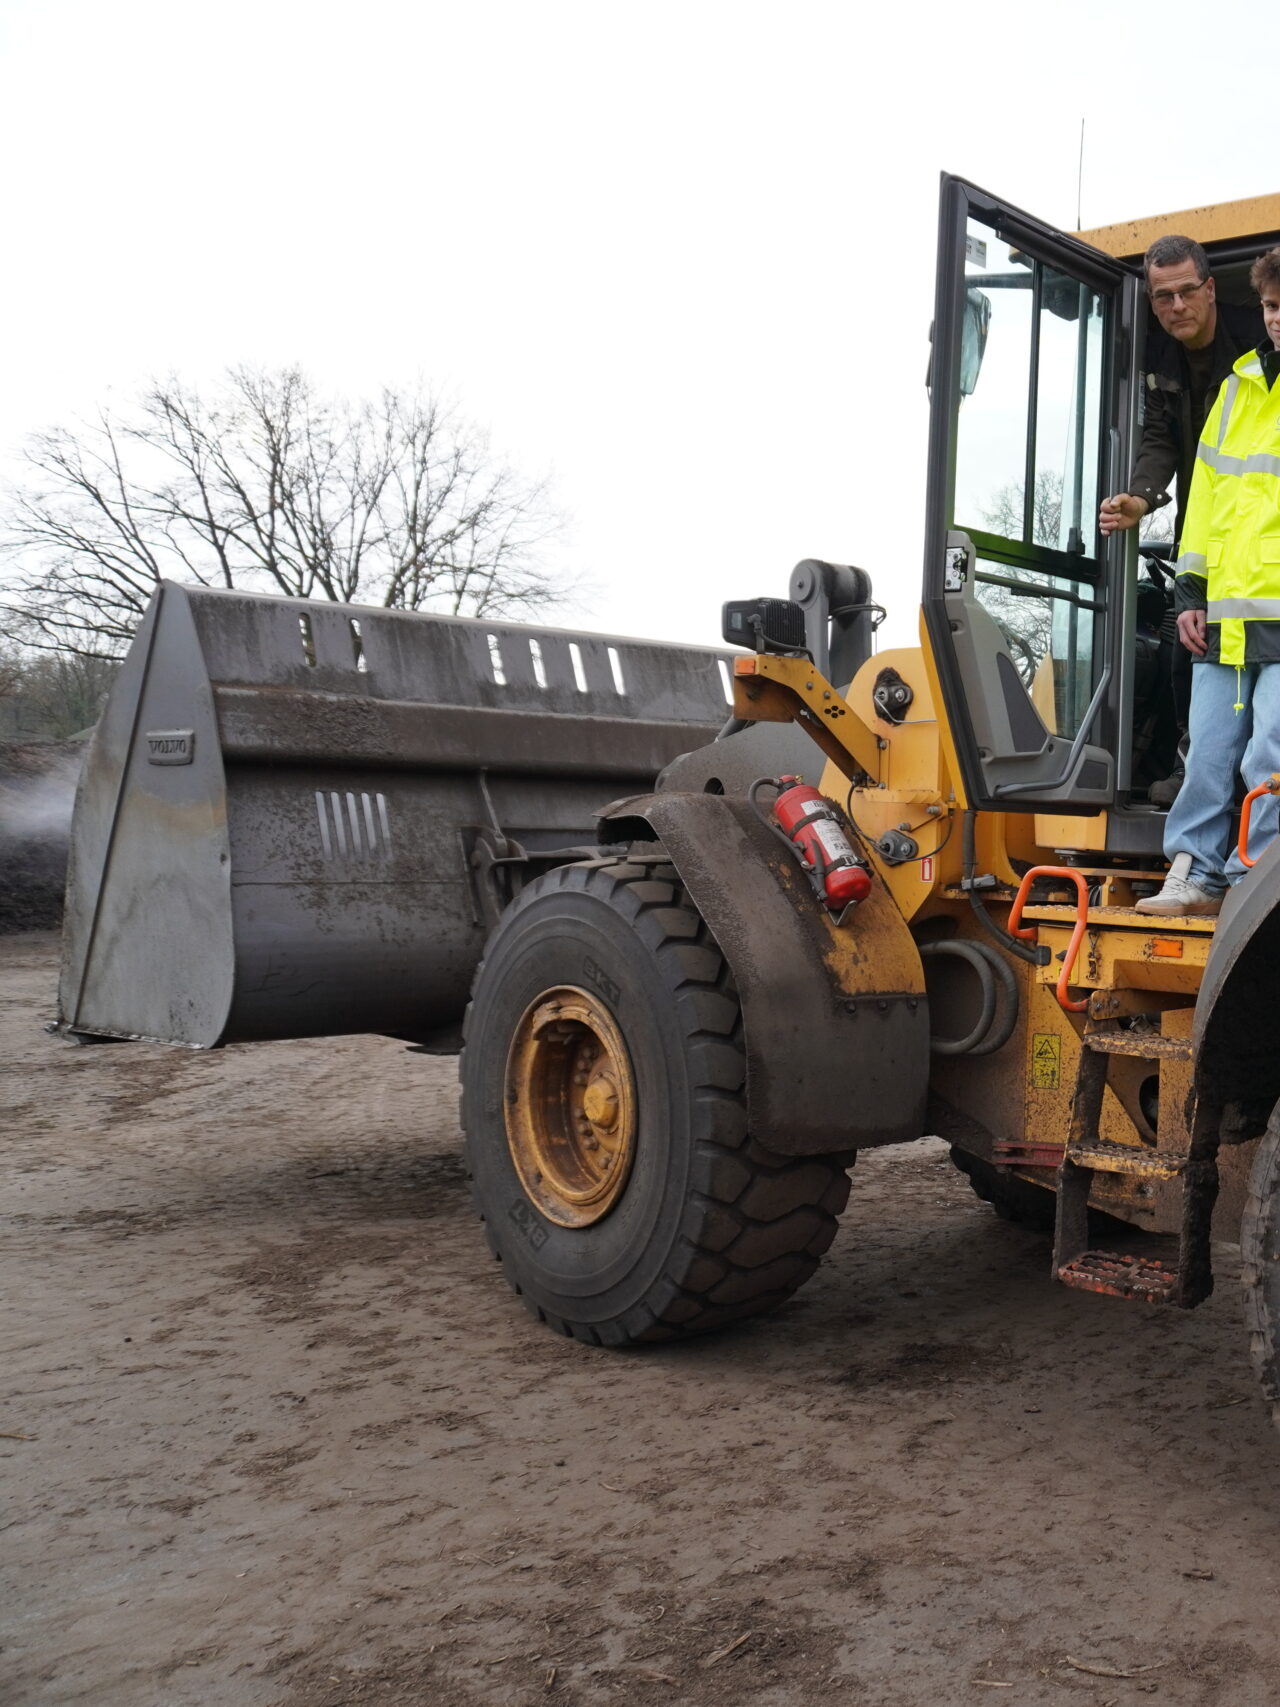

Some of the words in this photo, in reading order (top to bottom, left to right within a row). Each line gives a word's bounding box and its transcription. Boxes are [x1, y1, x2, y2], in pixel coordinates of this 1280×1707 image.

[147, 739, 187, 754] VOLVO
[584, 957, 620, 1005] BKT
[510, 1199, 550, 1251] BKT
